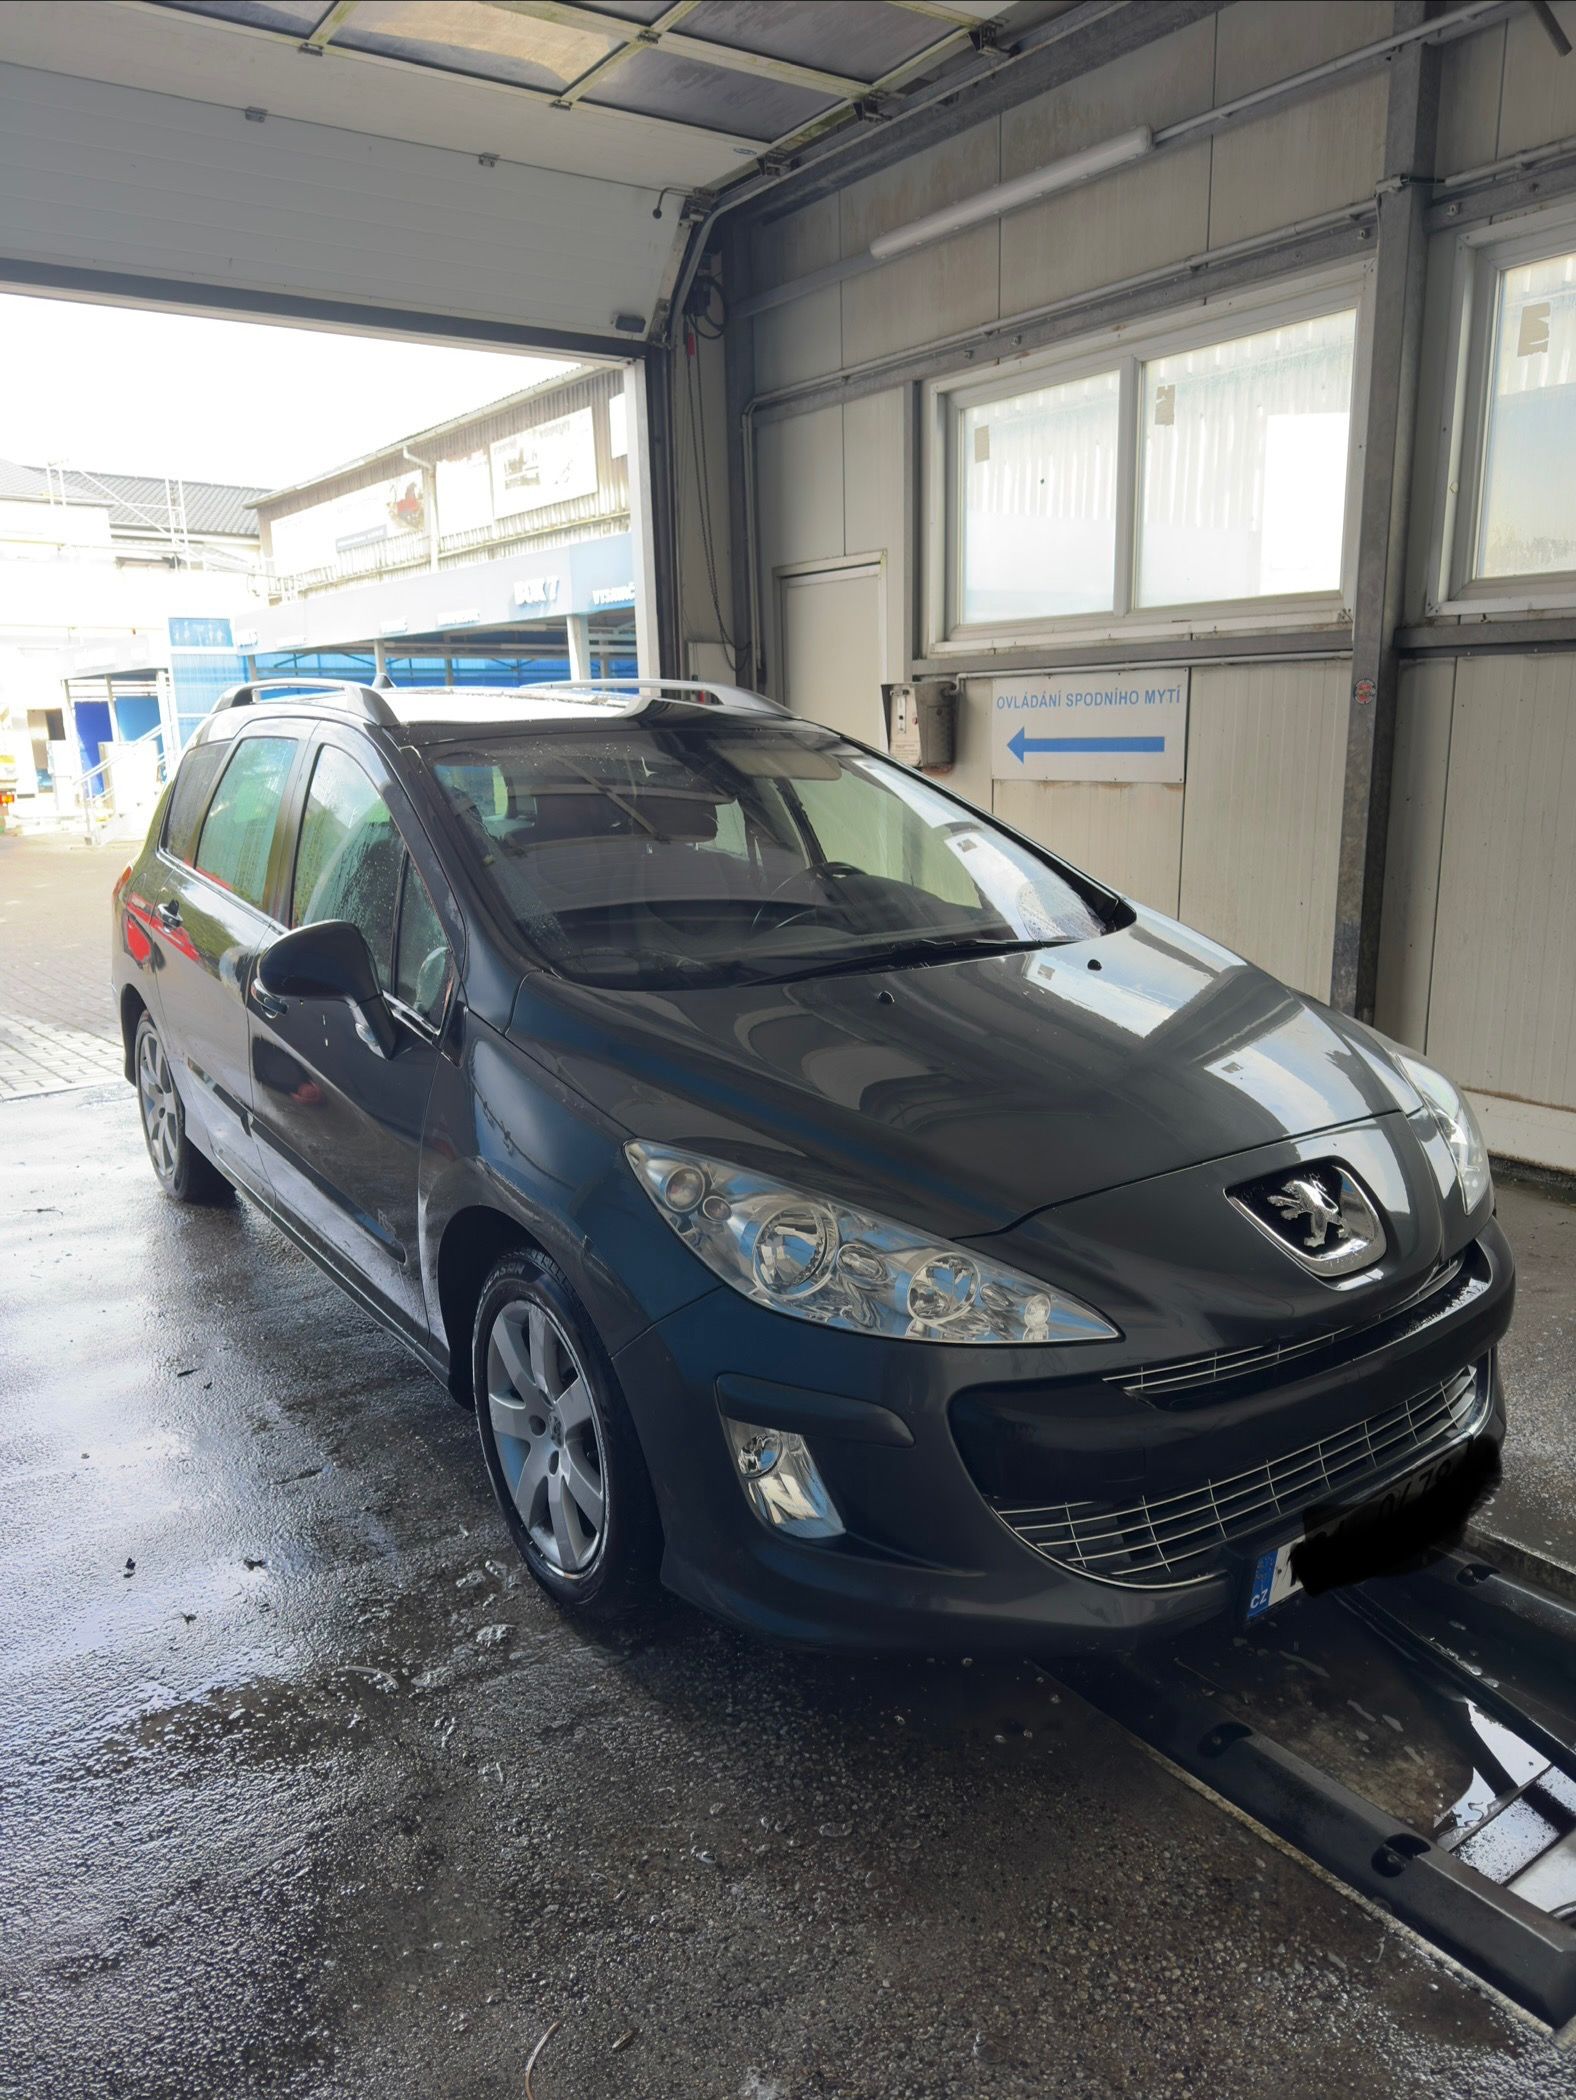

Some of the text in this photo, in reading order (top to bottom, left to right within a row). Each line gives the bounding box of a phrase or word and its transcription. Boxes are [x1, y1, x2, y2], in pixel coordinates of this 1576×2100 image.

[996, 685, 1182, 710] OVLÁDÁNÍ SPODNÍHO MYTÍ
[1250, 1588, 1268, 1608] CZ
